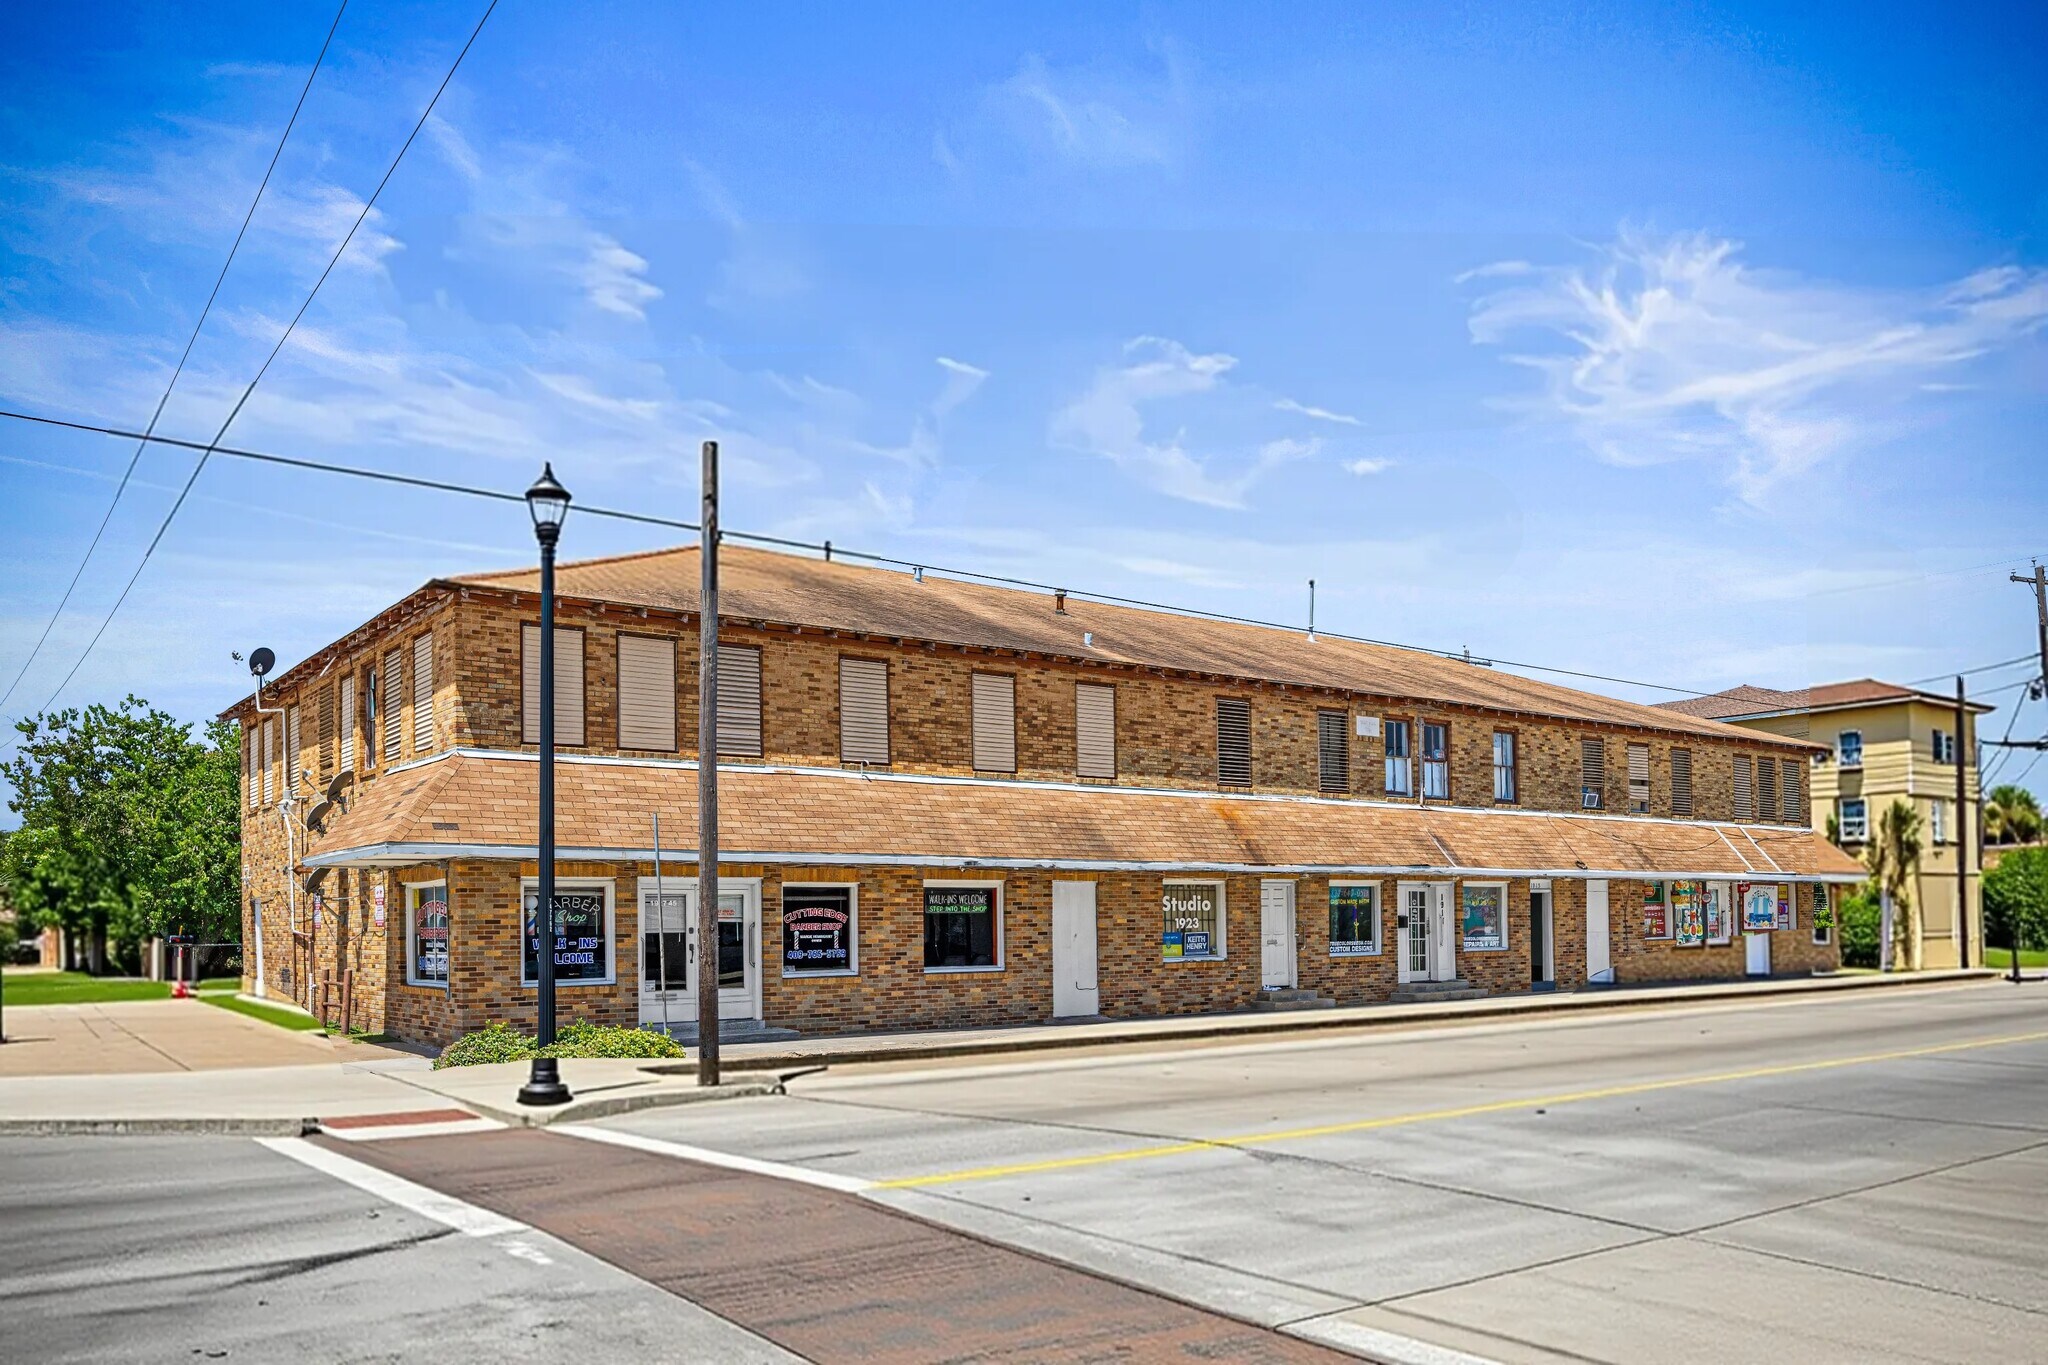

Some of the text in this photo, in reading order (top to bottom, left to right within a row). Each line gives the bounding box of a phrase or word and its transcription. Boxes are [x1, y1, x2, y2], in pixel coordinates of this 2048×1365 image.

[554, 896, 601, 915] ARBER
[928, 894, 987, 905] WALK-INS WELCOME
[1162, 895, 1212, 912] Studio
[783, 907, 849, 924] CUTTING EDGE
[960, 905, 970, 913] THE
[556, 909, 588, 925] Shop
[1174, 917, 1200, 929] 1923
[789, 922, 821, 931] BARBER
[532, 937, 567, 950] WK
[578, 937, 598, 949] INS
[1187, 935, 1206, 943] KEITH
[536, 952, 594, 965] LCOME
